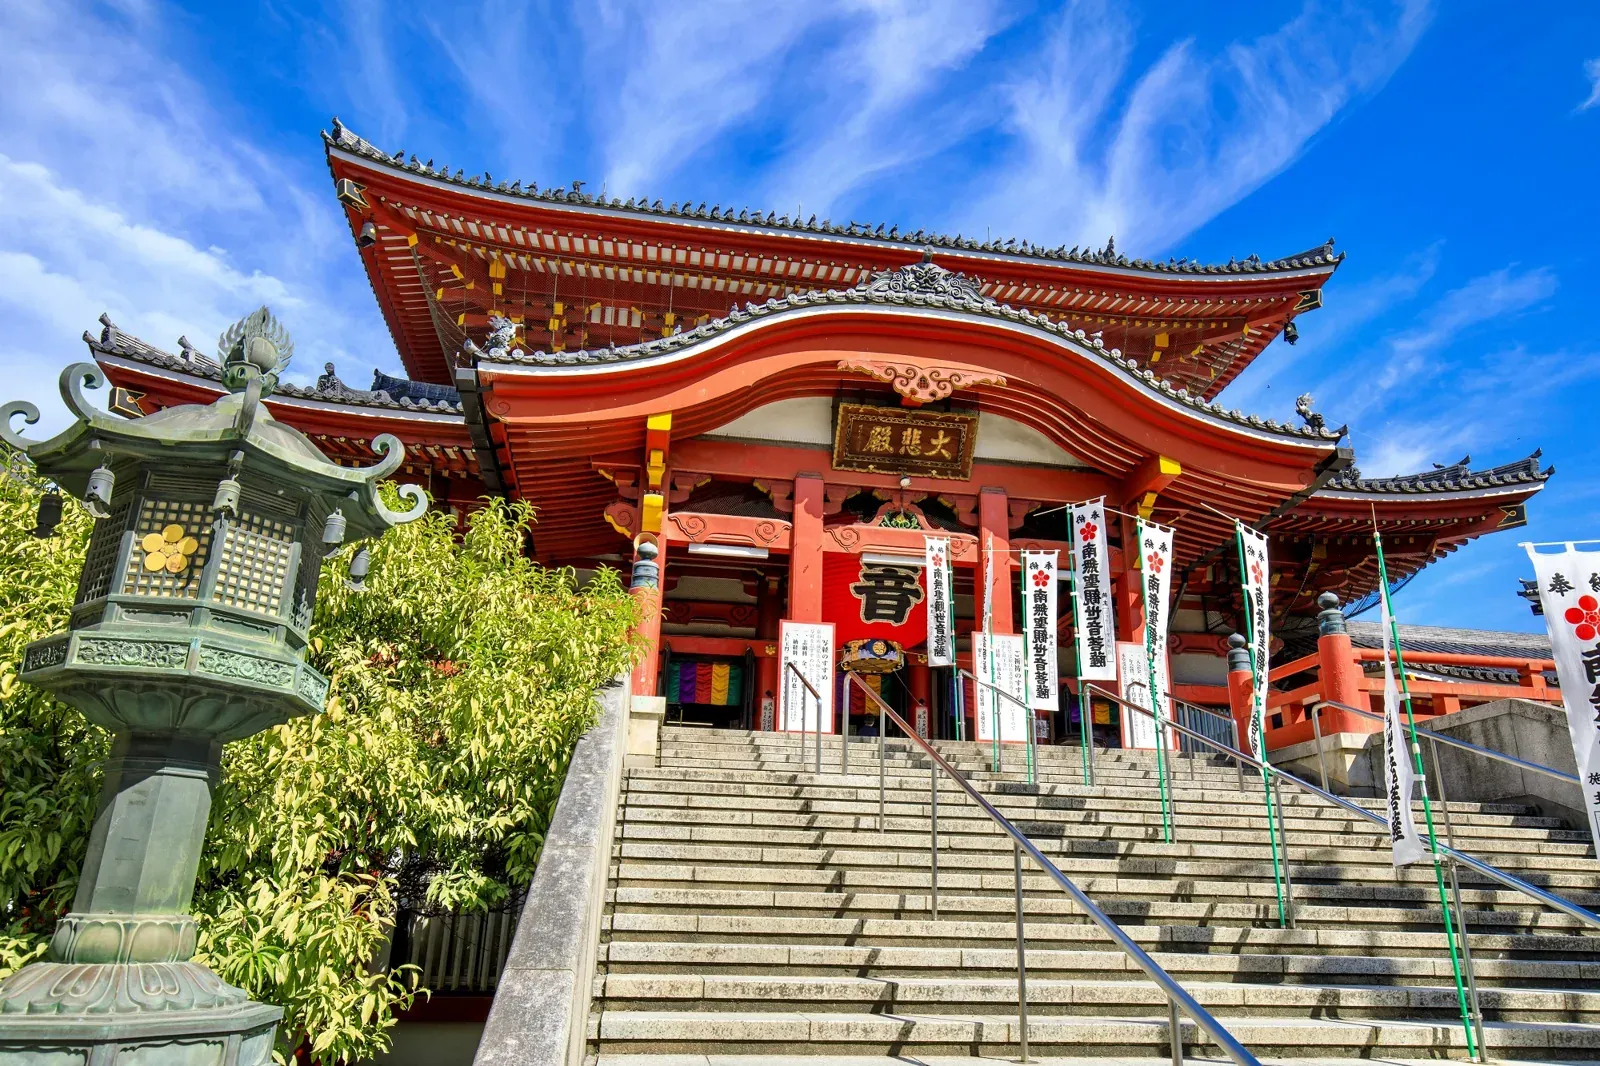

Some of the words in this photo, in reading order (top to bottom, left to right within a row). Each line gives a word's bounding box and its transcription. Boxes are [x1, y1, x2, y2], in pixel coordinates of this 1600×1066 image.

[862, 425, 952, 460] 大悲殿
[933, 568, 947, 657] 南無聖観世音菩薩
